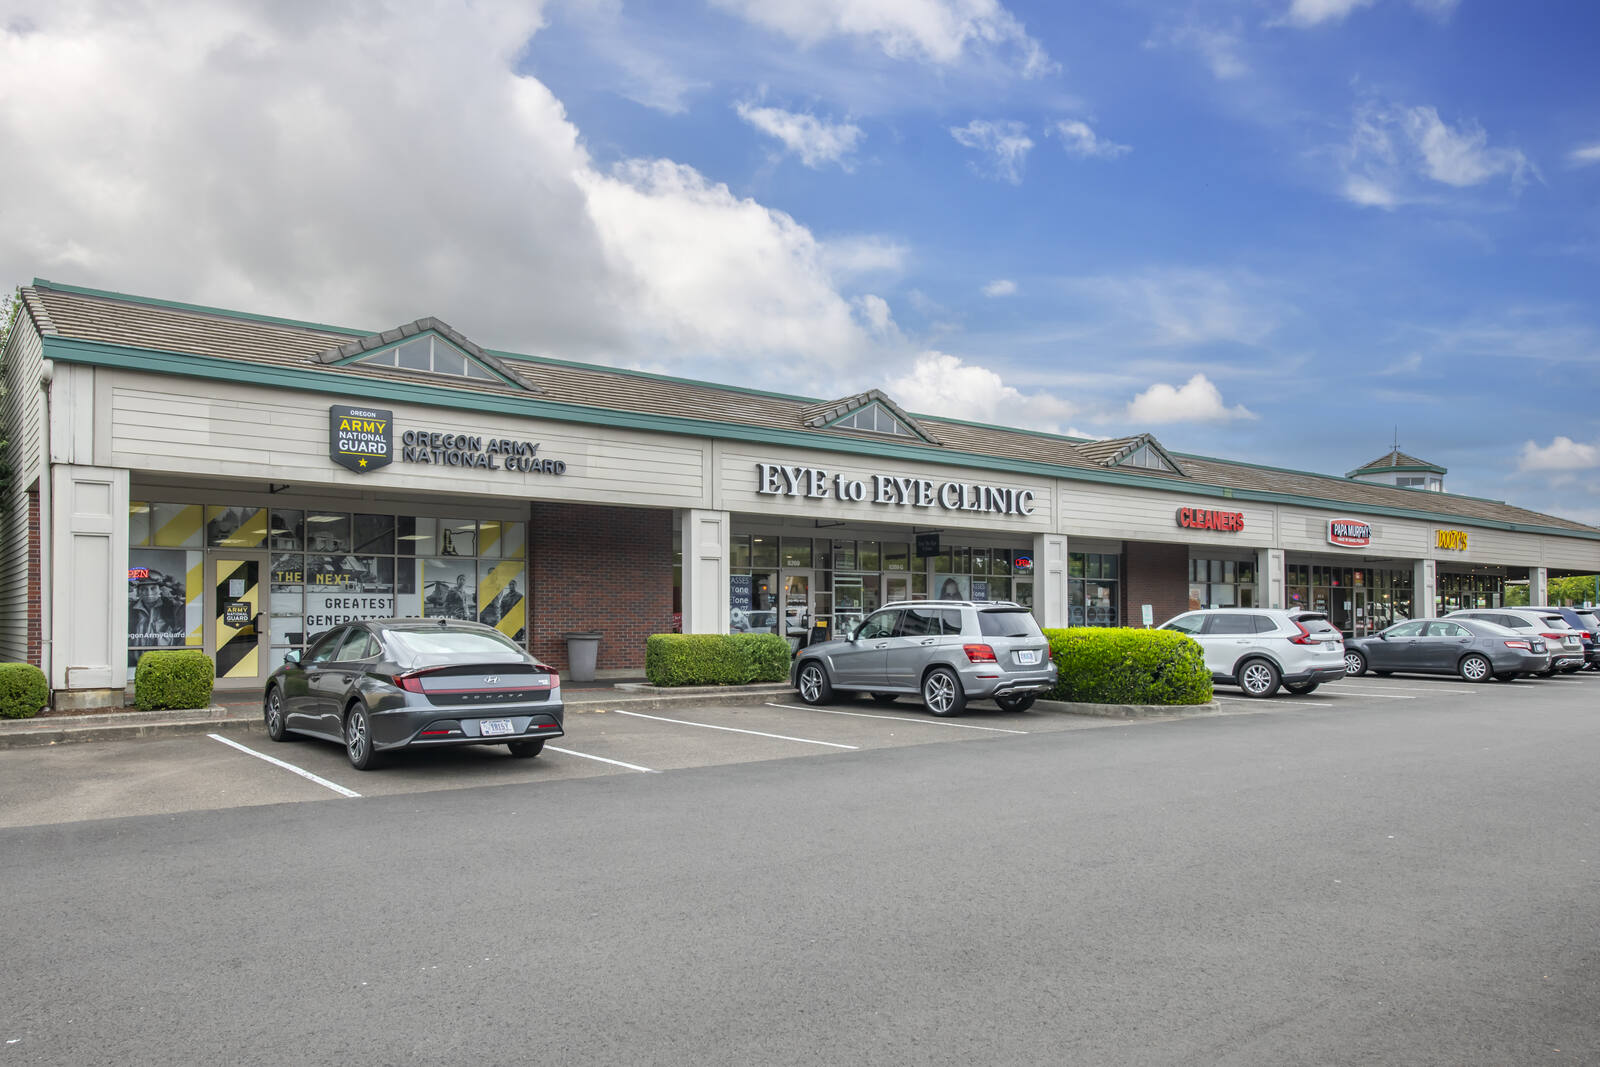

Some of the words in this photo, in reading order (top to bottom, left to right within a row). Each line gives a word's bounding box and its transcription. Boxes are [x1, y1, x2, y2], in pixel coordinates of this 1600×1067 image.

[350, 410, 376, 418] OREGON
[339, 419, 386, 434] ARMY
[339, 431, 386, 443] NATIONAL
[402, 430, 481, 452] OREGON
[487, 438, 540, 457] ARMY
[338, 440, 387, 454] GUARD
[402, 447, 500, 470] NATIONAL
[505, 456, 567, 475] GUARD
[756, 463, 829, 499] EYE
[834, 473, 867, 501] to
[872, 475, 935, 507] EYE
[939, 482, 1035, 516] CLINIC
[1176, 507, 1245, 532] CLEANERS
[1334, 524, 1348, 537] PAPA
[128, 569, 149, 578] PEN
[277, 571, 302, 583] THE
[316, 573, 350, 585] NEXT
[325, 598, 394, 609] GREATEST
[307, 615, 394, 626] GENERA
